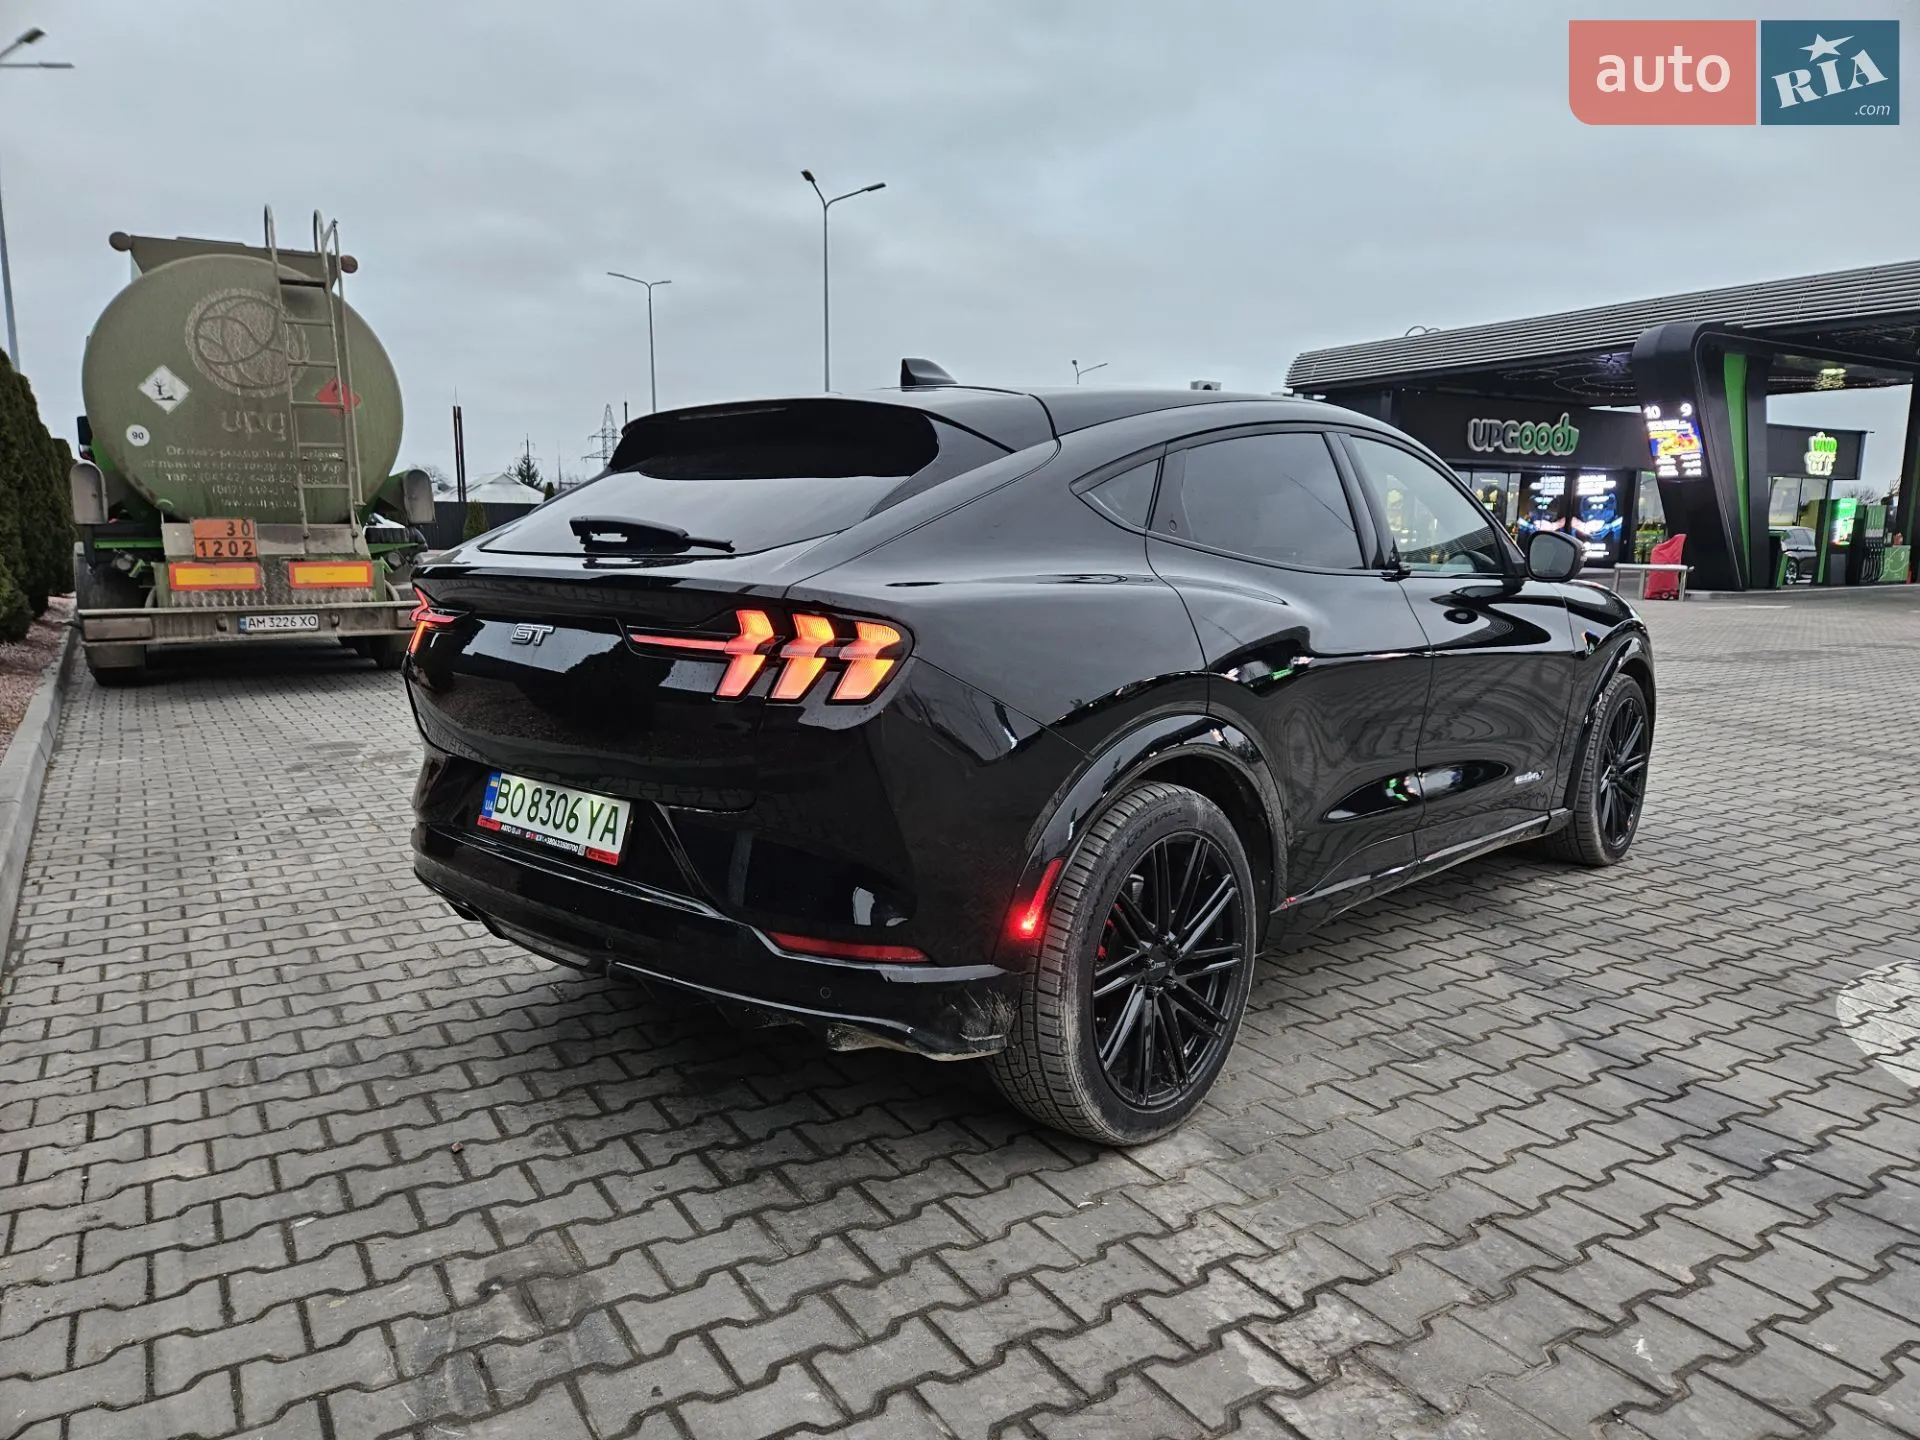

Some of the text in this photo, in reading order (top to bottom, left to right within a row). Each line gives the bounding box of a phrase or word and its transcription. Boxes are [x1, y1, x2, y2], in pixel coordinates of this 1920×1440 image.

[131, 431, 145, 441] 90
[226, 520, 251, 537] 30
[198, 540, 254, 557] 1202
[247, 615, 318, 628] AM 3226 XO
[511, 622, 554, 646] GT
[484, 802, 494, 812] UA
[494, 778, 619, 846] BO 8306 YA
